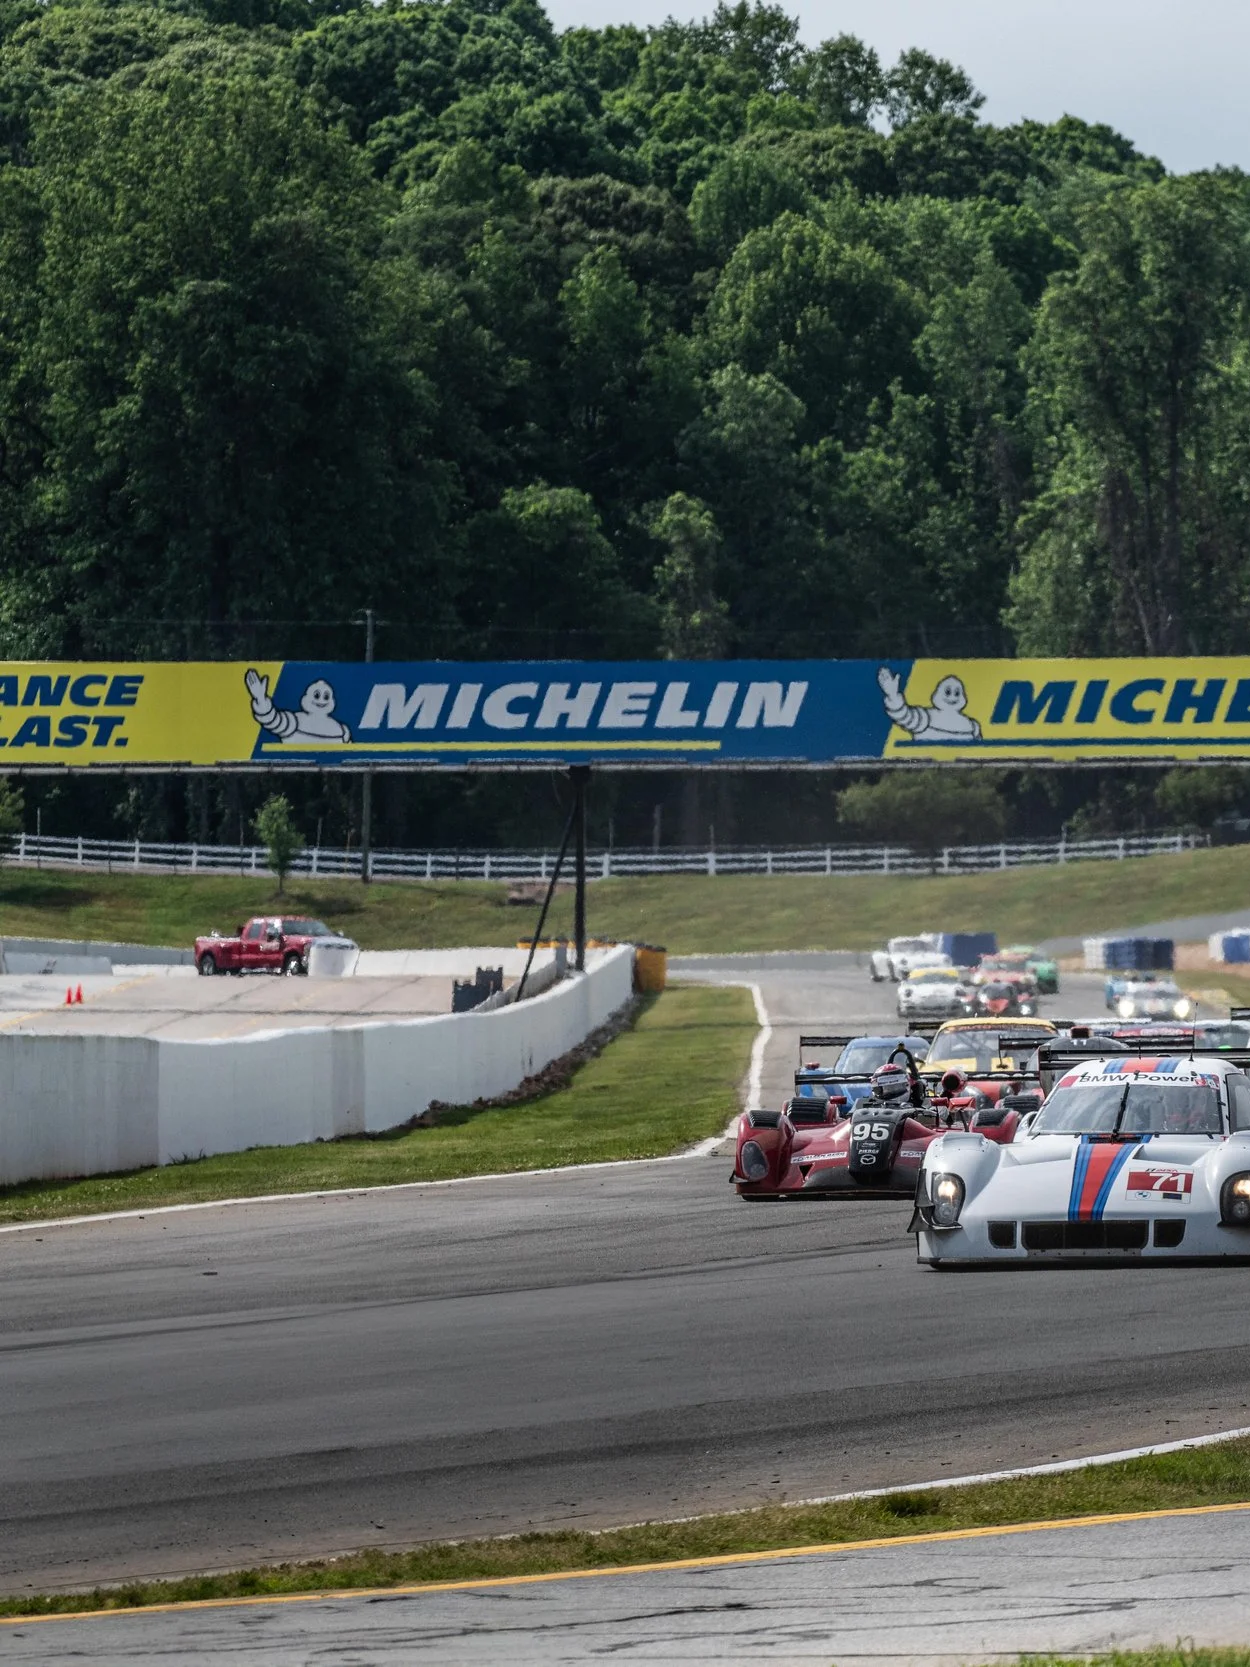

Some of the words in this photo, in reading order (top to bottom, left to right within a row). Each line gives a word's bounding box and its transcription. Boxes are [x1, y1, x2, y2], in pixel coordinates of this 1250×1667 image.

[358, 682, 808, 729] MICHELIN
[1080, 1074, 1127, 1083] BMW
[1133, 1073, 1196, 1082] Power
[853, 1123, 890, 1141] 95
[1149, 1172, 1186, 1192] 71
